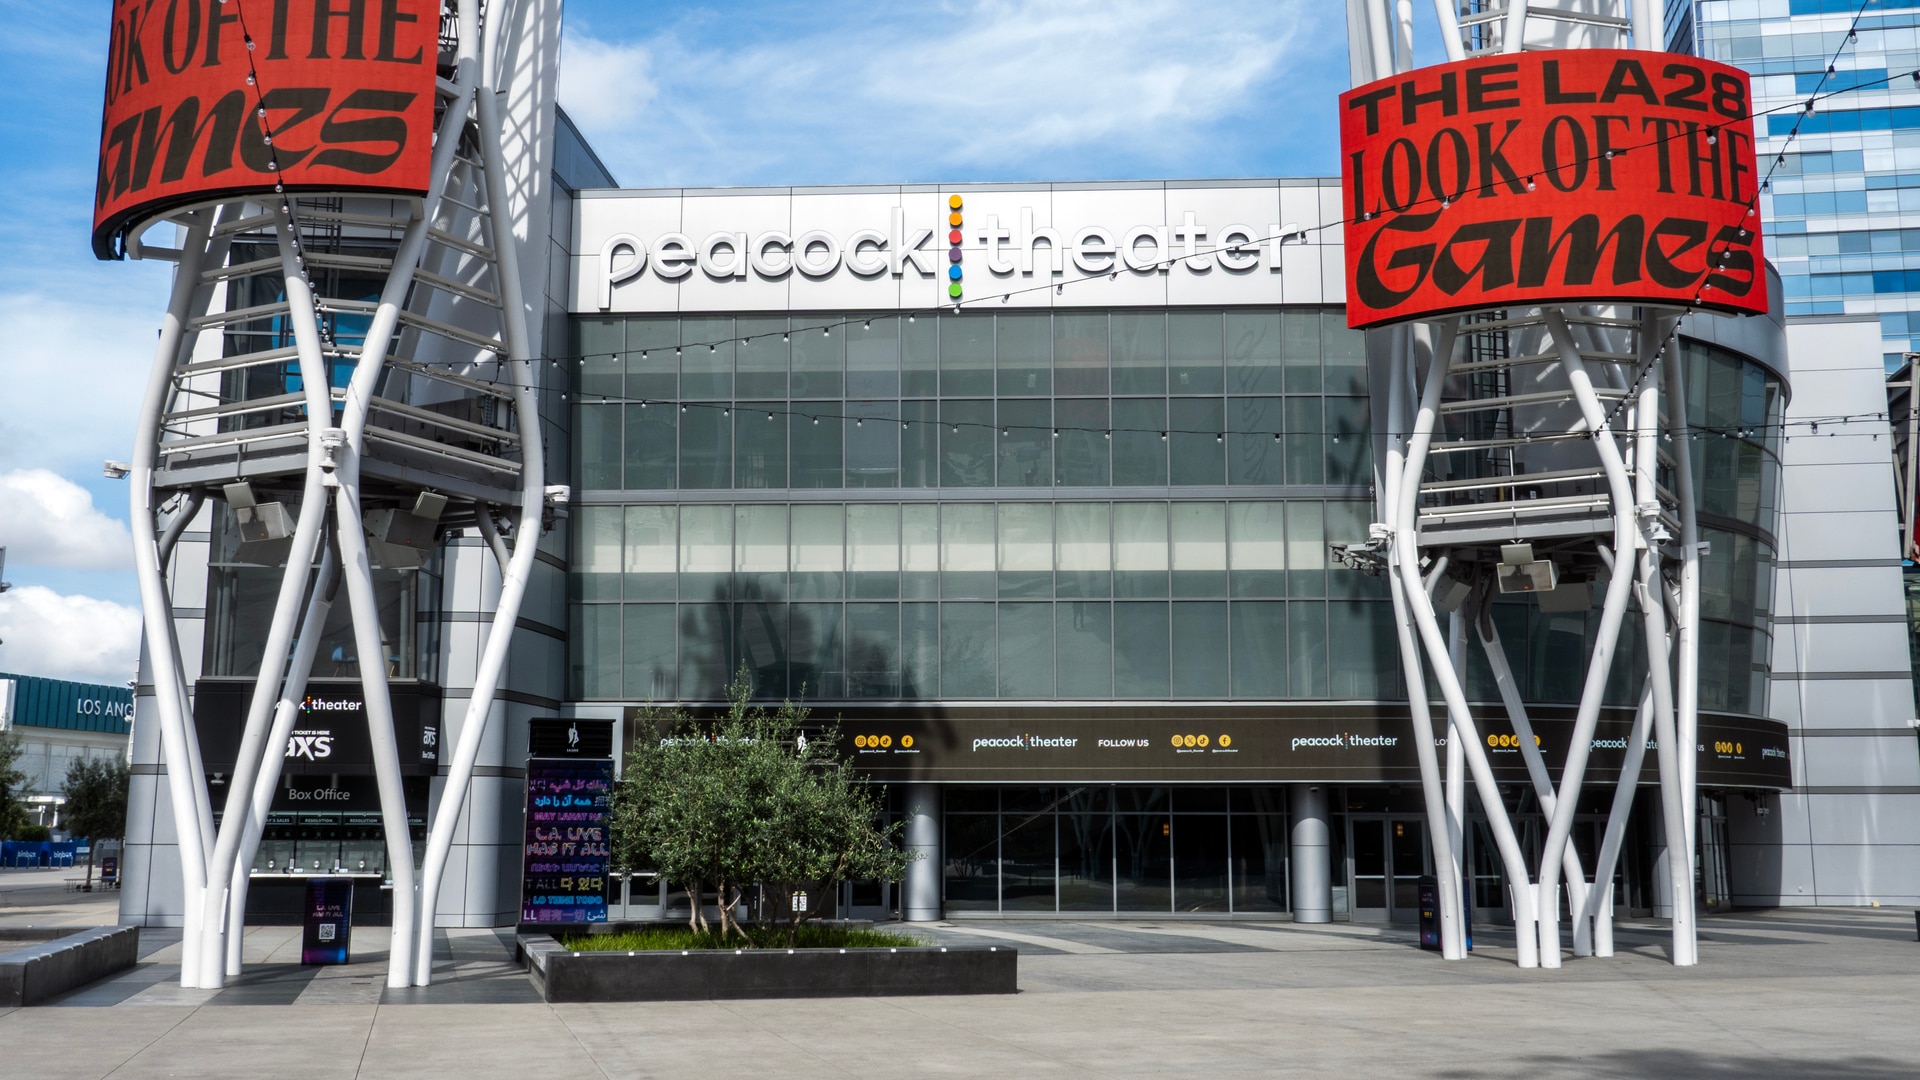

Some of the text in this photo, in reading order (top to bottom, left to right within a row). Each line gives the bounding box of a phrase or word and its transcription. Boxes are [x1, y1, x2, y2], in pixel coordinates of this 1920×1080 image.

[107, 0, 424, 107] OK OF THE
[1349, 59, 1746, 136] THE LA28
[100, 87, 419, 211] ames
[1351, 115, 1755, 224] LOOK OF THE
[598, 206, 1300, 310] peacock theater
[1355, 208, 1756, 309] Games
[77, 698, 101, 715] LOS
[312, 698, 362, 711] theater
[973, 735, 1078, 752] peacock theater
[1098, 739, 1149, 748] FOLLOW US
[1291, 734, 1398, 751] peacock theater
[1589, 737, 1628, 753] peacock
[288, 788, 351, 801] Box Office
[567, 827, 602, 841] LIVE
[526, 842, 610, 856] HAS IT ALL
[532, 895, 547, 905] LO
[575, 895, 603, 905] TODO
